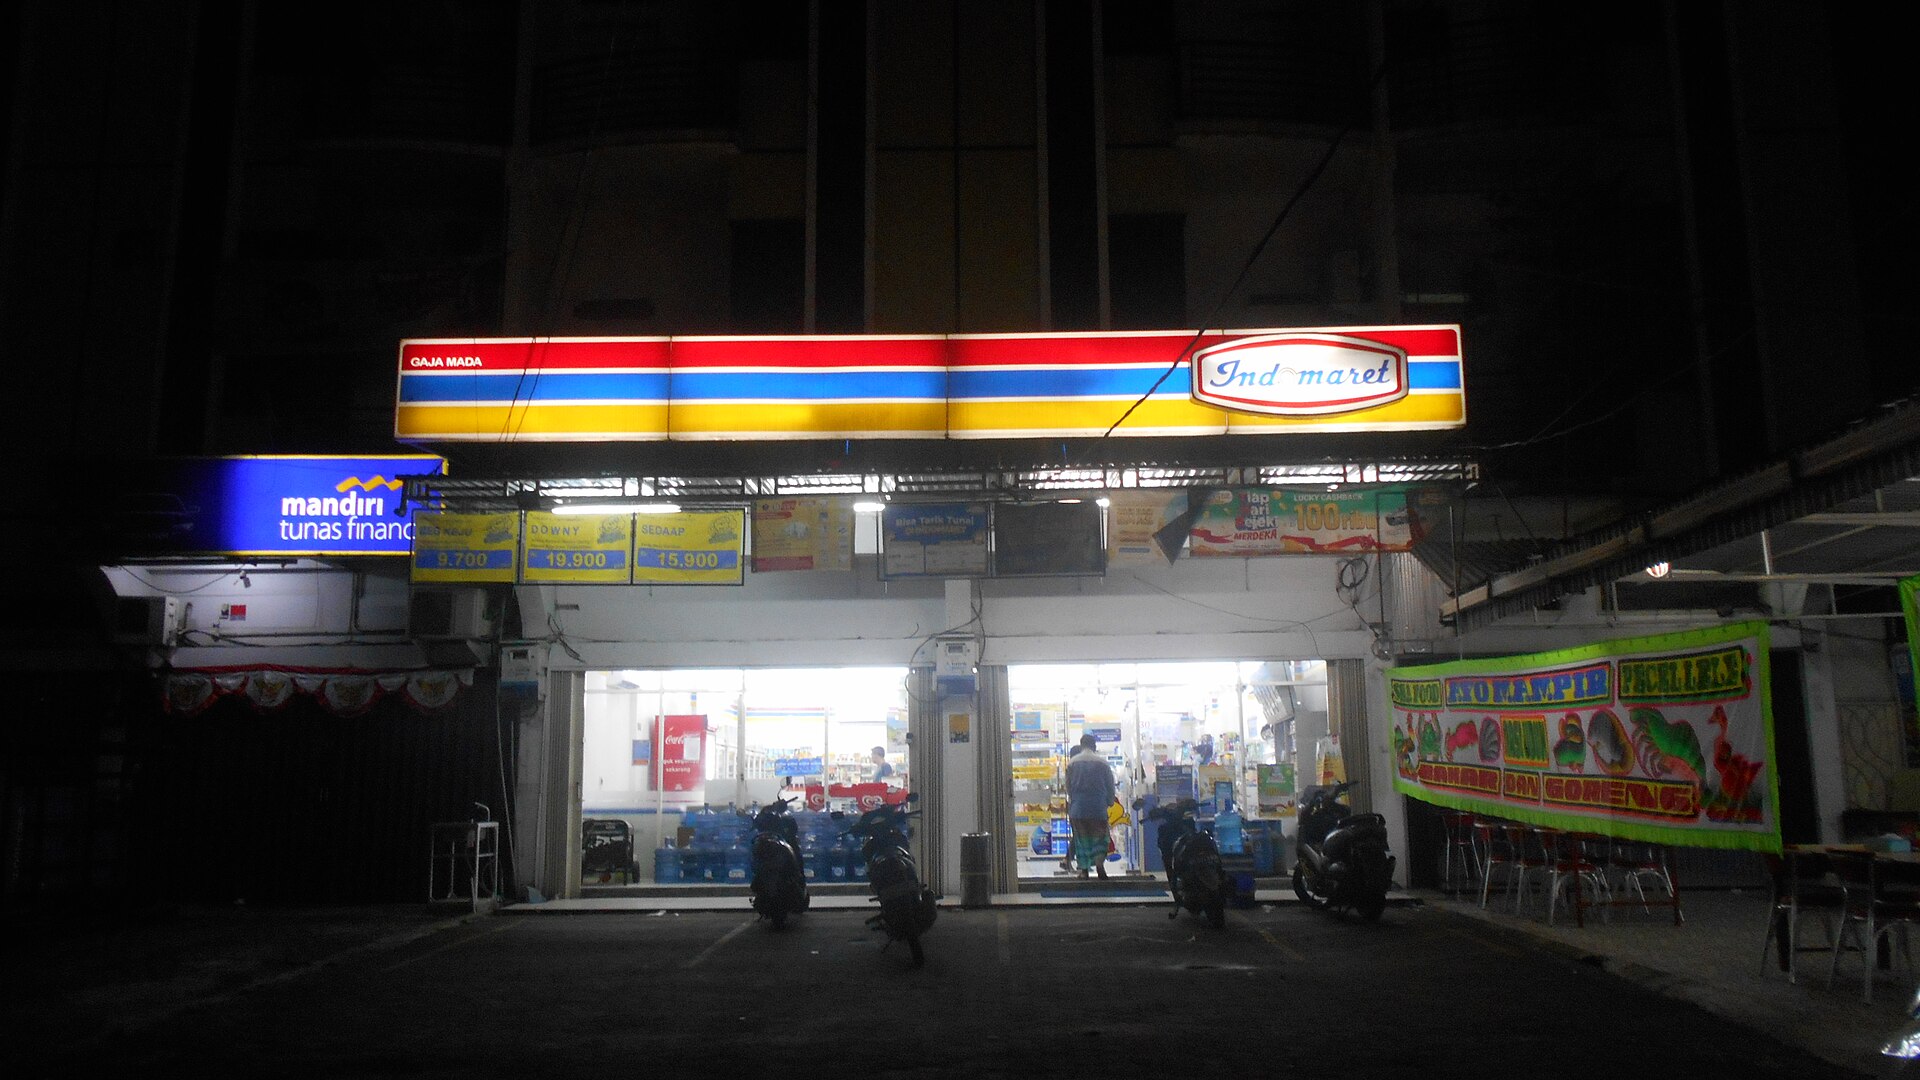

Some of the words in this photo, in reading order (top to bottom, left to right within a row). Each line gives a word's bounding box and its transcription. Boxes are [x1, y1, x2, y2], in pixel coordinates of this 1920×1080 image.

[410, 357, 444, 367] GAJA
[446, 357, 482, 367] MADA
[1210, 359, 1390, 387] Indmaret
[281, 491, 384, 516] mandiri
[1293, 494, 1319, 502] LUCKY
[1320, 493, 1364, 501] CASHBACK
[1294, 503, 1340, 531] 100
[280, 519, 342, 540] tunas
[346, 516, 416, 540] financ
[531, 525, 580, 536] DOWNY
[641, 524, 686, 537] SEDAAP
[1234, 529, 1277, 541] MERDEKA
[437, 552, 488, 567] 9.700
[546, 552, 606, 567] 19.900
[658, 552, 719, 568] 15.900
[1449, 679, 1490, 702] AYO
[1491, 669, 1608, 702] MAMPIR
[1505, 772, 1539, 799] DAN
[1545, 777, 1693, 813] GORENG
